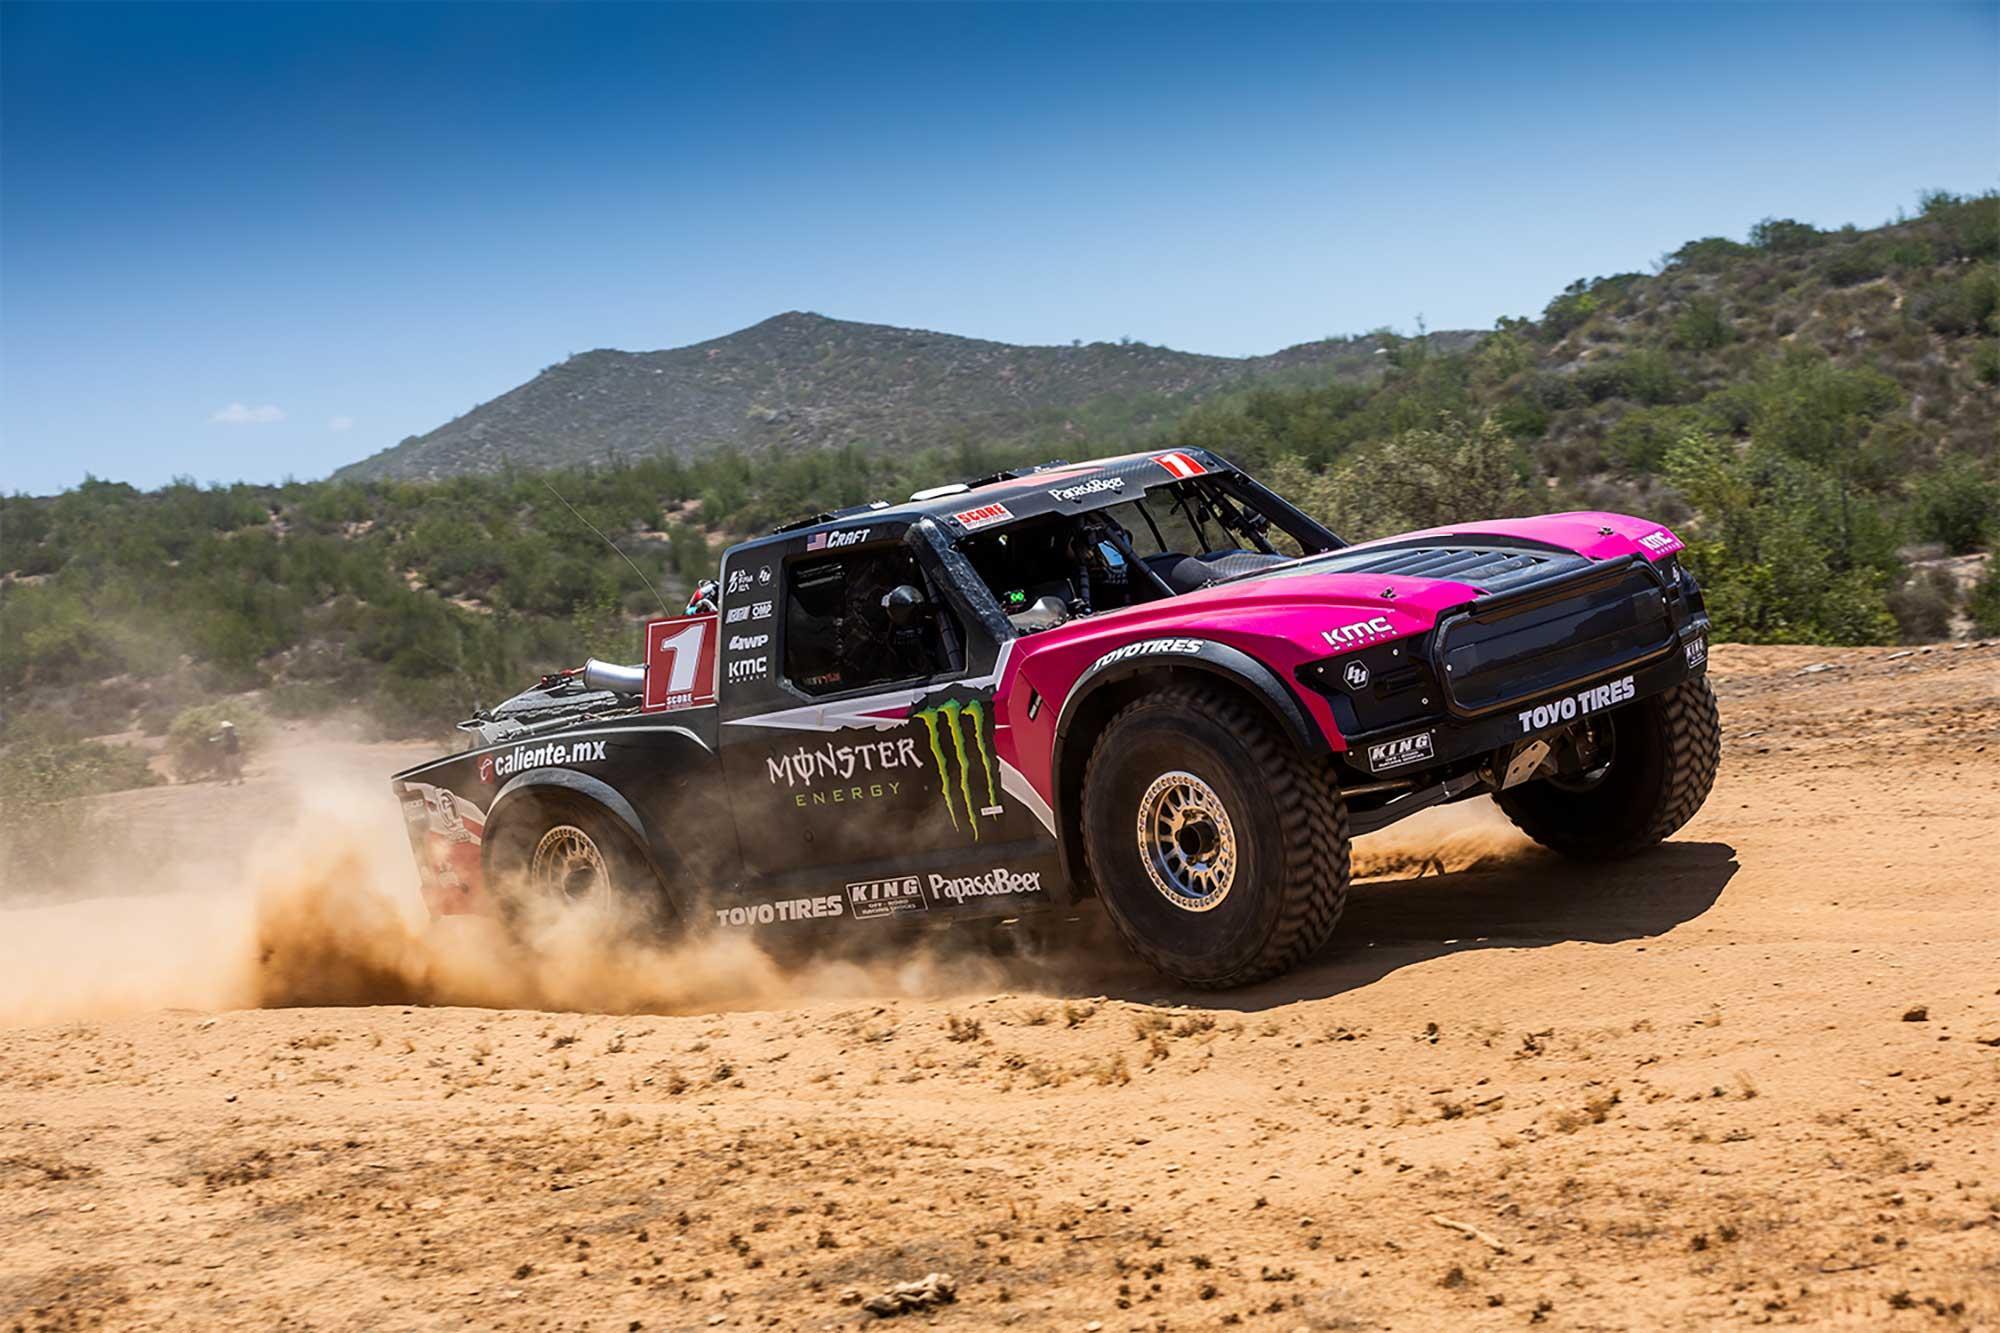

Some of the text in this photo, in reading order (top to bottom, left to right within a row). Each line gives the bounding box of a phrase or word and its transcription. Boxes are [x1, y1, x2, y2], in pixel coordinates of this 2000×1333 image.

[1160, 453, 1194, 477] 1
[957, 504, 1006, 523] SCORE
[1321, 616, 1393, 646] KMC
[661, 622, 707, 694] 1
[728, 656, 767, 677] KMC
[666, 693, 693, 705] SCORE
[1518, 675, 1636, 733] TOYO TIRES
[494, 740, 607, 777] caliente.mx
[1372, 735, 1429, 761] KING
[795, 782, 900, 807] ENERGY
[852, 879, 919, 902] KING
[928, 868, 1041, 904] Papas&Beer
[716, 895, 844, 927] TOYO TIRES
